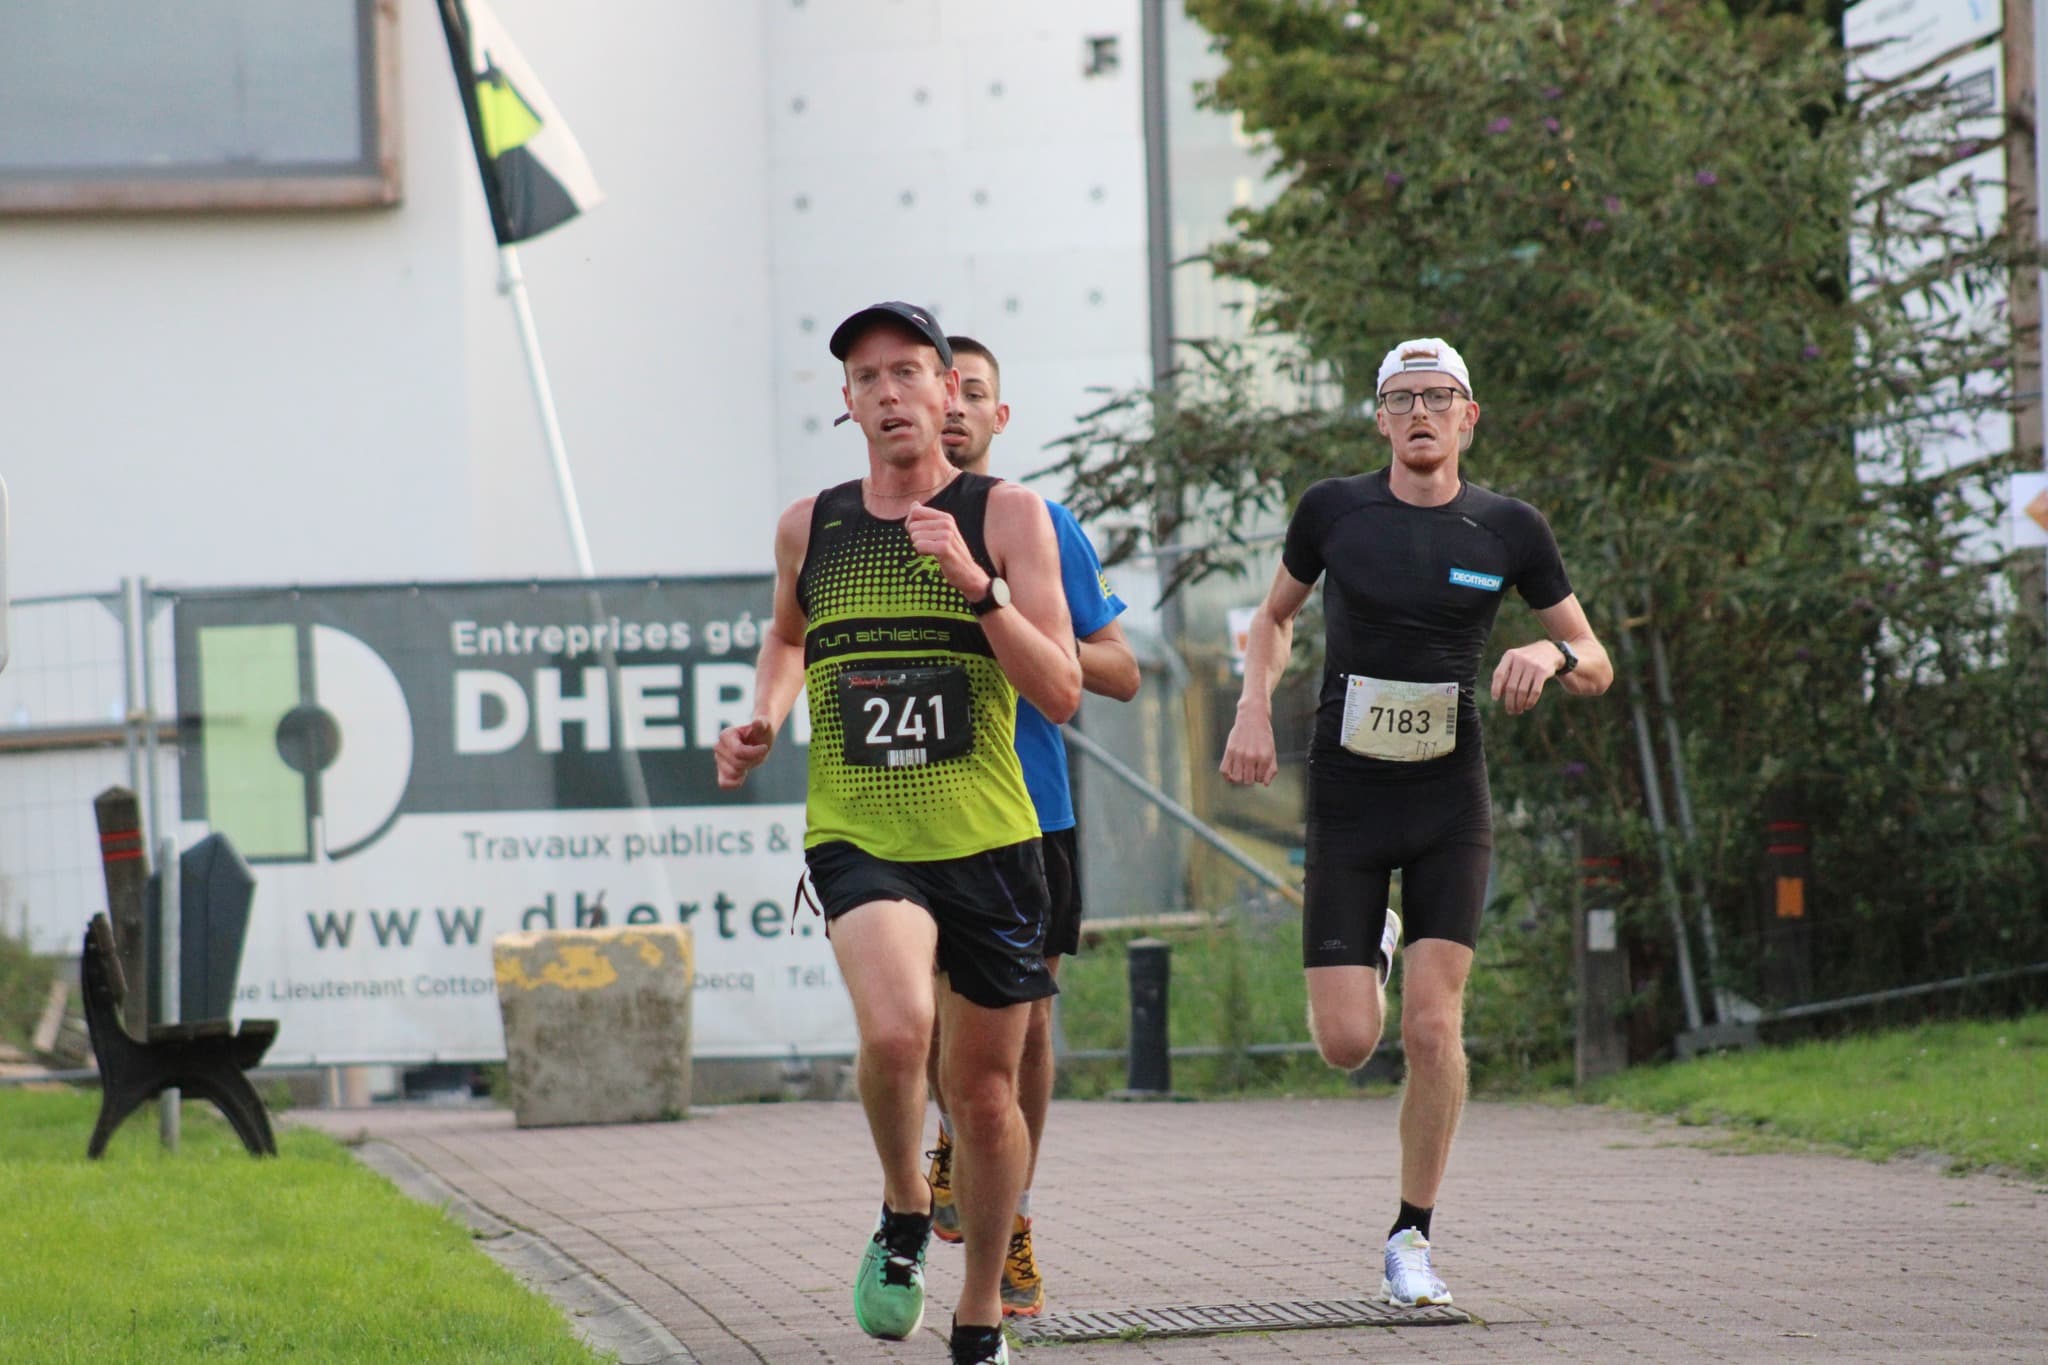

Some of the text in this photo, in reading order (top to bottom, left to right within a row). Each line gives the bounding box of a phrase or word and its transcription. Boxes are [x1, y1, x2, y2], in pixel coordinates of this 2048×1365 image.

[452, 618, 691, 659] Entreprises
[819, 627, 950, 649] run athletics
[863, 694, 946, 744] 241
[1370, 706, 1431, 734] 7183
[463, 822, 792, 862] Travaux publics &
[271, 975, 405, 1002] Lieutenant
